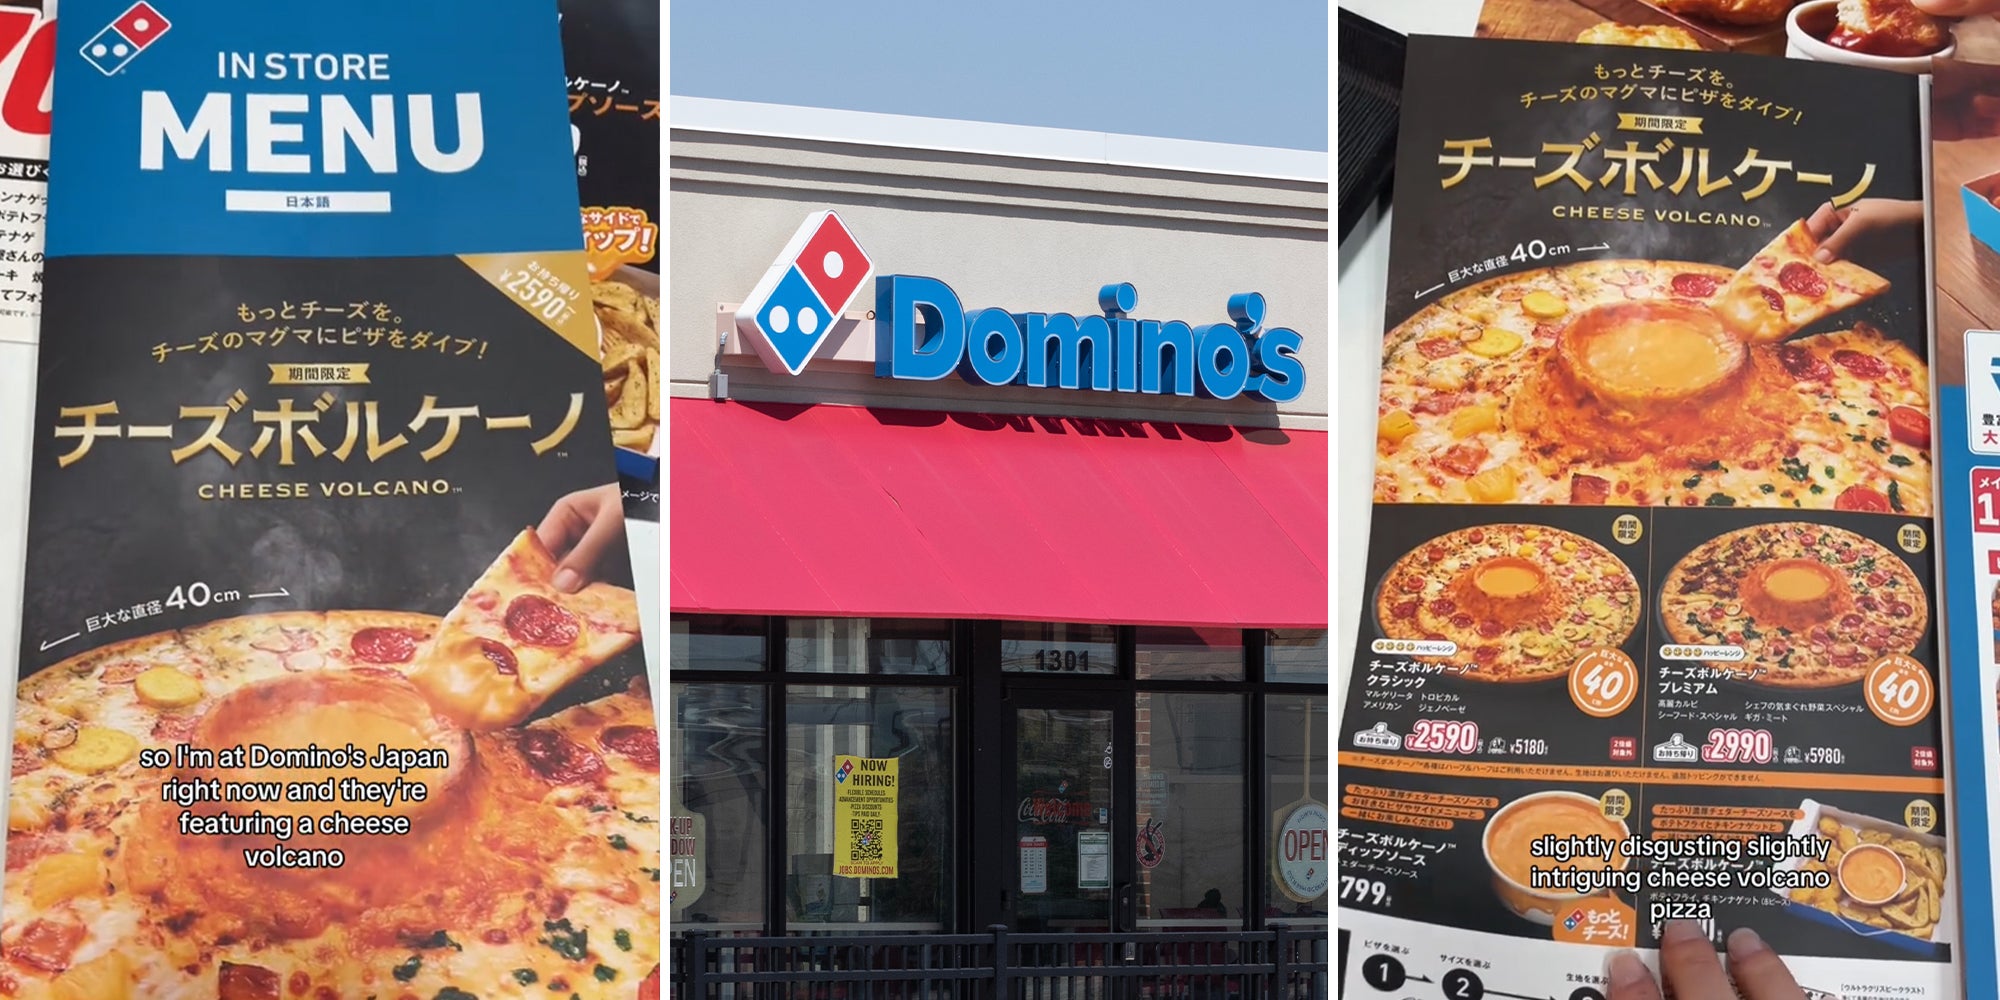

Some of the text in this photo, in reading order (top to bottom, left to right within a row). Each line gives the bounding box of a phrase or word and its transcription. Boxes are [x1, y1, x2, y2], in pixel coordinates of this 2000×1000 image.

[218, 51, 390, 80] IN STORE
[1593, 63, 1734, 89] もっとチーズを。
[1519, 84, 1804, 126] チーズのマグマにピザをダイブ!
[139, 90, 485, 174] MENU
[1634, 116, 1688, 131] 期間限定
[285, 196, 331, 209] 日本語
[1552, 205, 1644, 222] CHEESE
[499, 269, 566, 319] ¥2590
[236, 300, 402, 325] もっとチーズを。
[151, 325, 488, 363] チーズのマグマにピザをダイブ!
[876, 274, 1306, 404] Domino's
[287, 366, 352, 381] 期間限定
[198, 482, 310, 499] CHEESE
[1902, 529, 1922, 539] 期間
[1903, 539, 1922, 548] 限定
[1036, 649, 1089, 671] 1301
[1703, 649, 1741, 658] ハッピーレンジ
[1366, 675, 1426, 688] クラシック
[1582, 663, 1625, 700] 40
[1659, 682, 1718, 695] プレミアム
[1878, 671, 1920, 708] 40
[1364, 690, 1460, 702] マルゲリータ トロピカル
[1363, 700, 1466, 714] アメリカン ジェノベーゼ
[1658, 700, 1865, 714] 高麗カルビ シェフの気まぐれ野菜スペシャル
[1406, 721, 1477, 752] ¥2590
[1510, 738, 1545, 756] ¥5180
[1658, 749, 1695, 758] お持ち帰り
[1704, 730, 1769, 762] ¥2990
[1804, 747, 1841, 765] ¥5980
[860, 760, 887, 771] NOW
[852, 775, 895, 787] HIRING!
[1351, 797, 1477, 818] お好きなピザやサイドメニューと
[1910, 806, 1931, 817] 期間
[1659, 820, 1777, 832] ポテトフライとチキンナゲットと
[1910, 817, 1931, 827] 限定
[1337, 842, 1427, 867] ディップソース
[839, 865, 894, 875] JOBS.DOMINOS.COM
[1338, 858, 1419, 879] ェダーチーズソース
[1586, 909, 1621, 924] もっと
[1582, 924, 1630, 942] チーズ!
[1364, 938, 1411, 955] ピザを選ぶ
[1439, 953, 1492, 970] サイズを選ぶ
[1378, 962, 1389, 982] 1
[1456, 977, 1470, 998] 2
